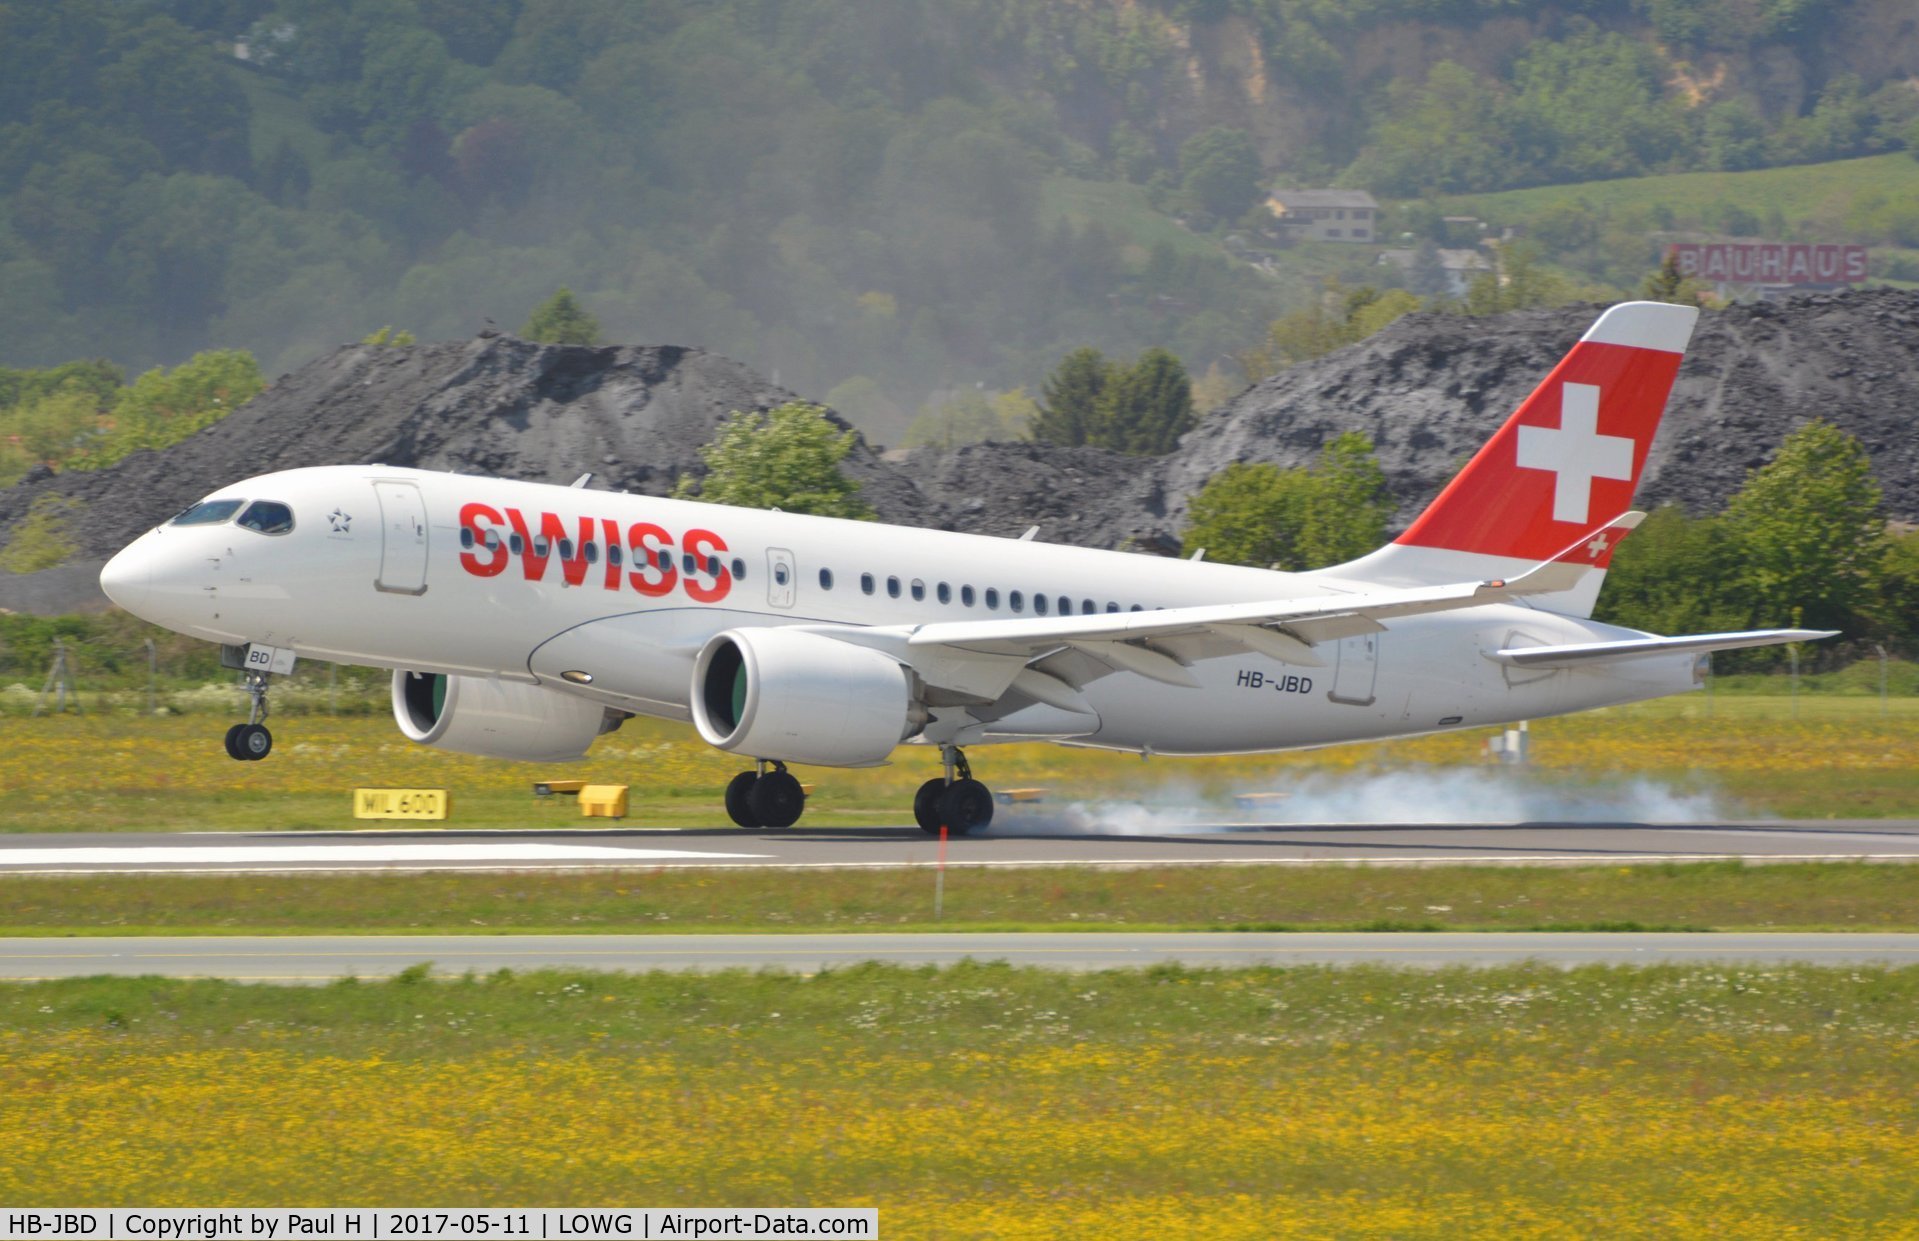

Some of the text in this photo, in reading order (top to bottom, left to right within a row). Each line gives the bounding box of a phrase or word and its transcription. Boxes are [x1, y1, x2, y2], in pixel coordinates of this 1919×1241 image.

[1679, 249, 1866, 277] BAUHAUS
[459, 502, 732, 604] SWISS
[249, 650, 270, 665] BD
[1237, 669, 1313, 694] HB-JBD
[398, 793, 438, 813] 600
